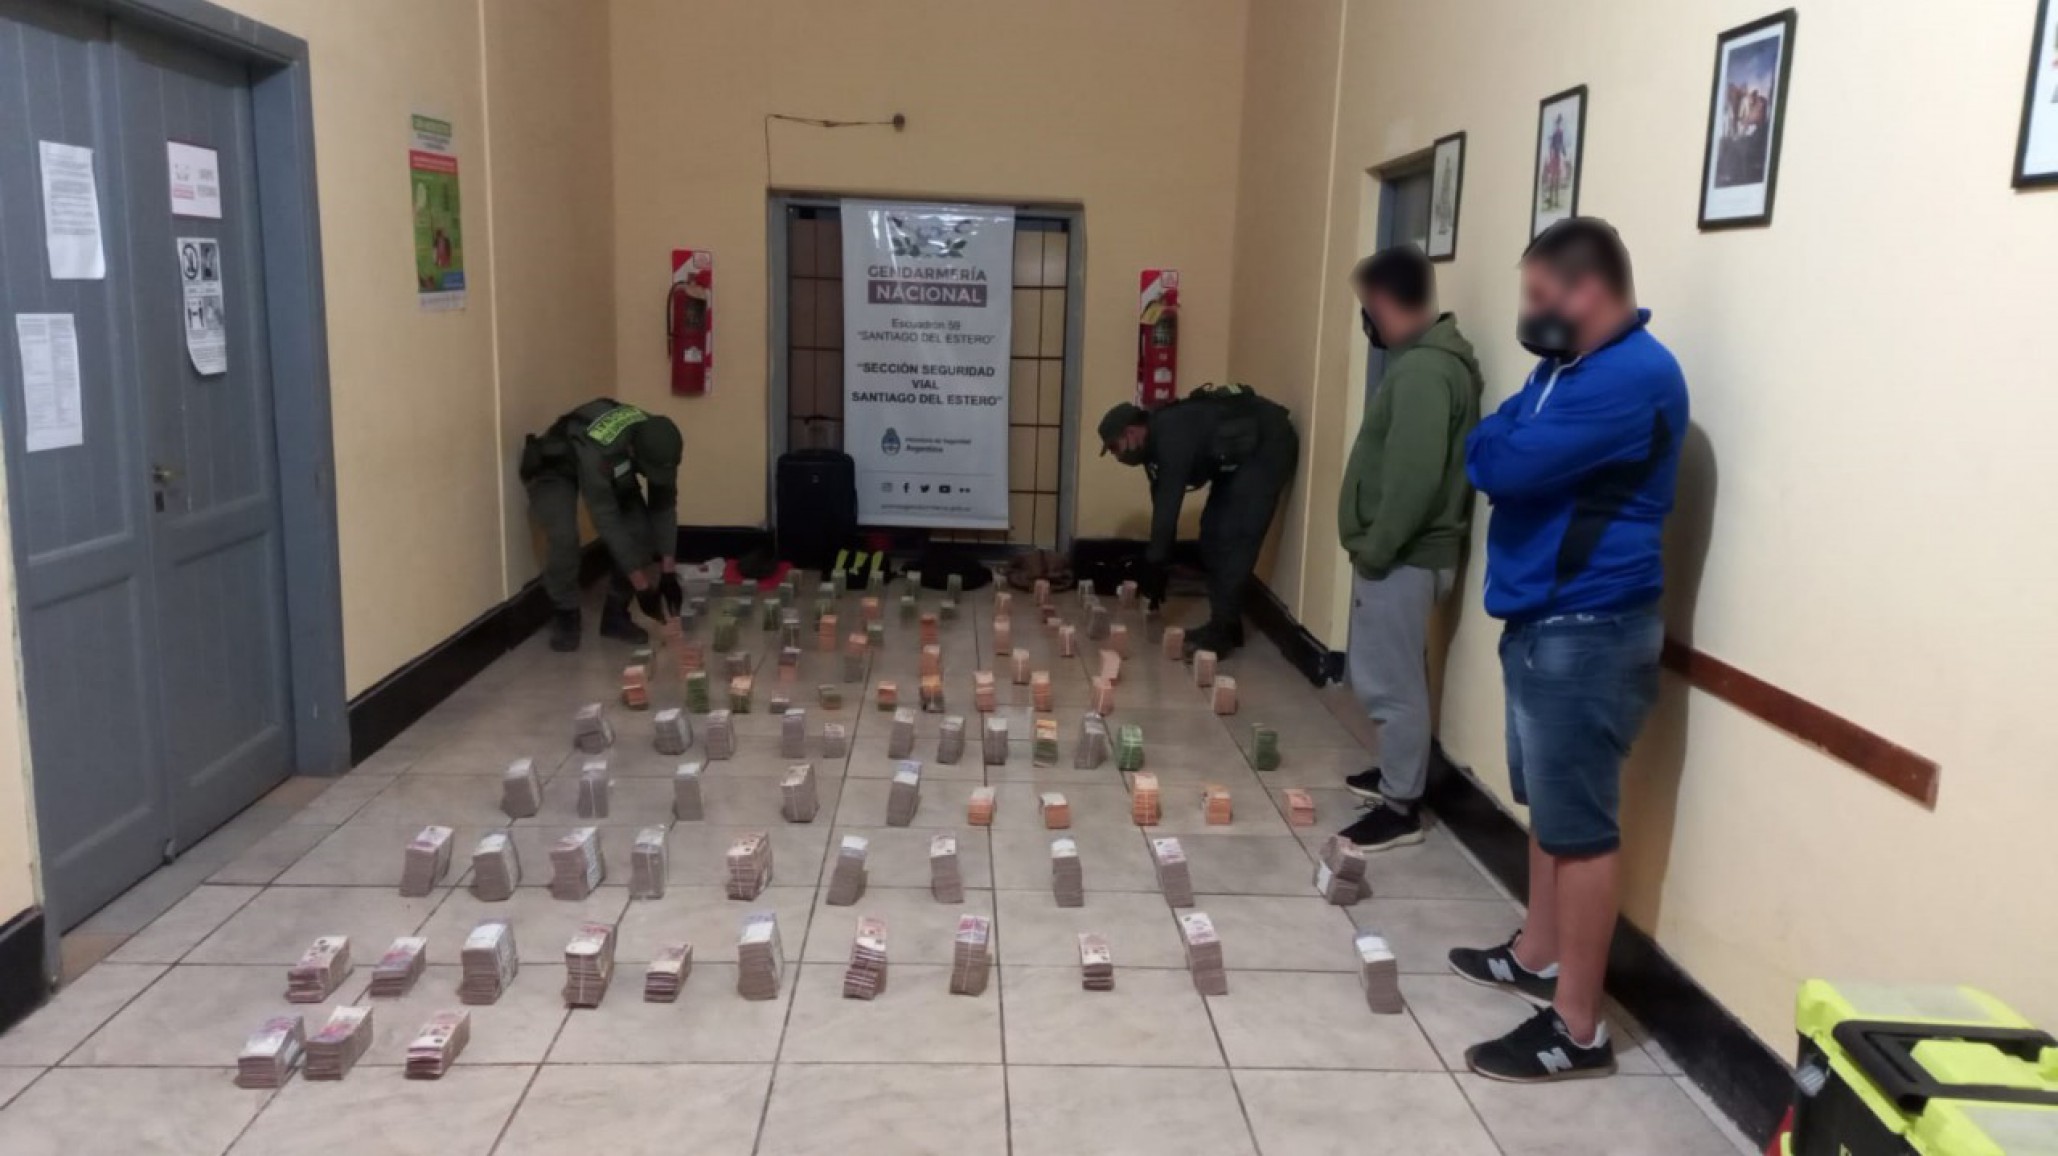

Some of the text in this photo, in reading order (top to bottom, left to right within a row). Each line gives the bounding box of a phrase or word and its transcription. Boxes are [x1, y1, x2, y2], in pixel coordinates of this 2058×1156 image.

[867, 264, 987, 281] GENDARMERÍA
[876, 284, 982, 303] NACIONAL
[921, 333, 941, 344] DEL
[922, 364, 995, 378] SEGURIDAD
[912, 379, 939, 390] VIAL
[851, 390, 917, 404] SANTIAGO
[920, 393, 942, 405] DEL
